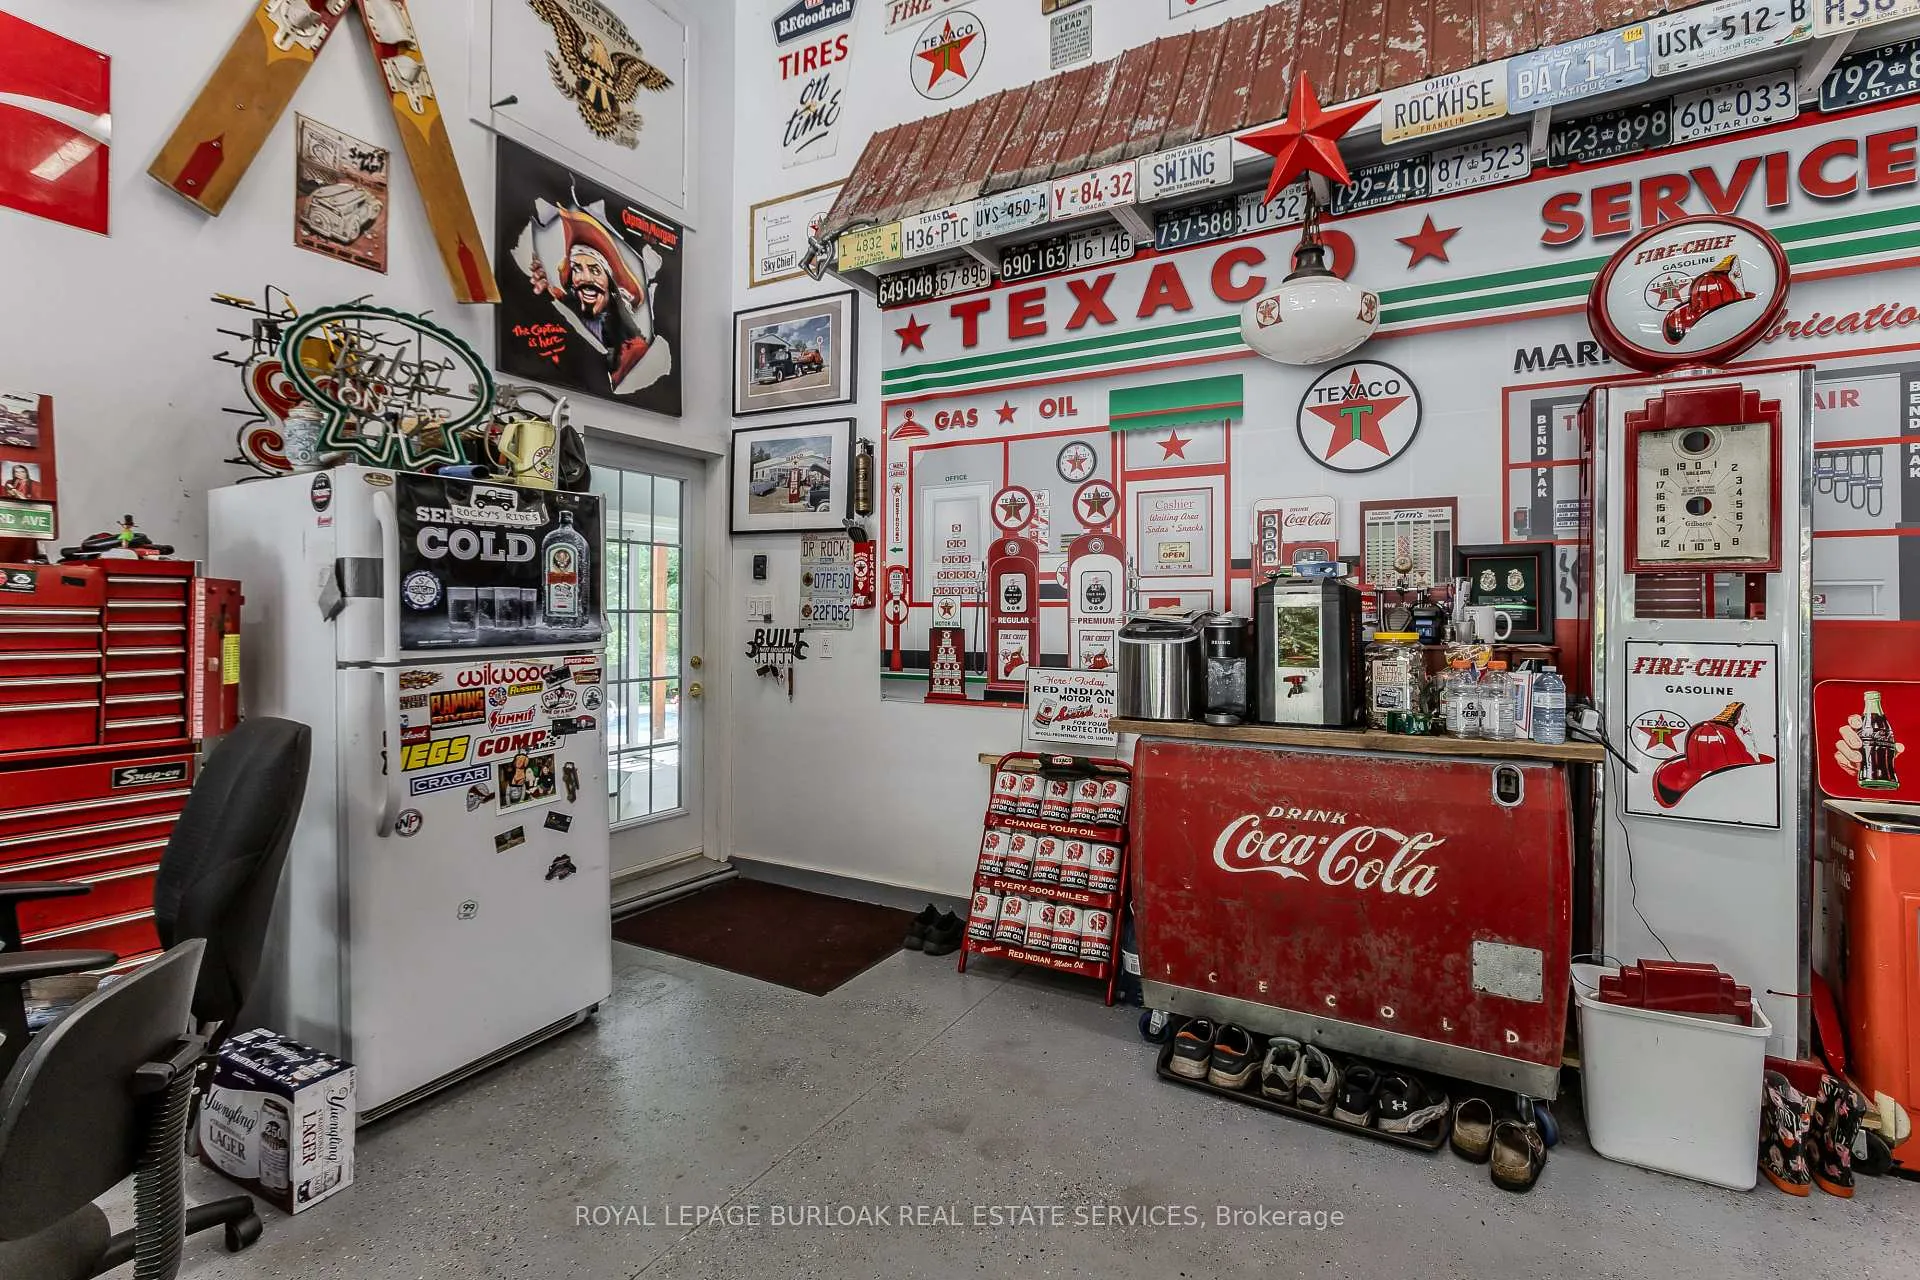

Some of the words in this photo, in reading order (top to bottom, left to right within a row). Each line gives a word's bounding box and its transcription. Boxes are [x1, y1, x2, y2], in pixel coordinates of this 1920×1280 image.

[1060, 19, 1082, 32] LEAD
[1657, 1, 1807, 57] USK-512-B
[921, 23, 975, 51] TEXACO
[778, 34, 848, 80] TIRES
[1518, 59, 1572, 99] BA7
[1584, 43, 1641, 82] 111
[1829, 61, 1885, 98] 792
[800, 72, 830, 105] on
[1424, 75, 1460, 92] OHIO
[1395, 79, 1494, 129] ROCKHSE
[1736, 82, 1792, 116] 033
[1420, 116, 1464, 133] FRANKLIN
[1551, 125, 1599, 158] N23
[1617, 110, 1667, 144] 898
[1692, 115, 1760, 137] ONTARIO
[1165, 146, 1203, 161] ONTARIO
[1481, 142, 1525, 173] 523
[1577, 142, 1639, 161] ONTARIO
[1153, 151, 1215, 187] SWING
[1360, 162, 1400, 176] ONTARIO
[1447, 172, 1500, 189] ONTARIO
[1540, 127, 1919, 245] SERVICE
[920, 214, 941, 225] TEXAS
[976, 193, 1047, 227] UVS-450-A
[622, 208, 649, 235] Captain
[649, 220, 679, 246] Morgan
[940, 218, 969, 243] PTC
[856, 237, 882, 252] 4832
[1634, 234, 1737, 266] FIRE-CHIEF
[763, 259, 776, 273] Sky
[777, 253, 794, 269] Chief
[1662, 255, 1716, 272] GASOLINE
[951, 230, 1356, 348] TEXACO
[513, 325, 530, 336] The
[531, 324, 567, 336] Captain
[539, 335, 564, 348] here
[1314, 379, 1402, 404] TEXACO
[934, 408, 979, 431] GAS
[1039, 395, 1078, 419] OIL
[1536, 414, 1547, 457] BEND
[1660, 468, 1669, 476] 18
[1677, 463, 1686, 471] 19
[1731, 463, 1738, 471] 2
[945, 474, 968, 482] OFFICE
[1537, 466, 1547, 498] PAK
[1656, 481, 1665, 489] 17
[1736, 488, 1742, 496] 4
[1155, 499, 1195, 510] Cashier
[1656, 504, 1665, 512] 15
[1736, 500, 1743, 508] 5
[23, 514, 48, 527] AVE
[456, 507, 500, 520] ROCKY'S
[506, 511, 538, 521] RIDES
[1149, 513, 1179, 522] Waiting
[1393, 510, 1423, 521] Tom's
[1736, 512, 1743, 520] 6
[1175, 523, 1204, 532] Snacks
[1736, 524, 1743, 532] 7
[416, 526, 536, 562] COLD
[803, 541, 814, 557] DR
[820, 540, 845, 557] ROCK
[1694, 543, 1704, 551] 10
[814, 572, 850, 589] 07PF30
[755, 628, 804, 647] BUILT
[1632, 656, 1768, 678] FIRE-CHIEF
[509, 682, 543, 694] RUSSELL
[1041, 676, 1072, 685] Here!
[1075, 677, 1108, 687] Today
[1665, 685, 1734, 696] GASOLINE
[1033, 686, 1059, 694] RED
[1064, 687, 1114, 697] INDIAN
[1060, 695, 1091, 703] MOTOR
[432, 690, 485, 713] FLAMING
[432, 711, 485, 723] RIVER
[1639, 717, 1686, 729] TEXACO
[478, 730, 547, 757] COMP
[120, 769, 181, 785] Snap-on
[416, 769, 486, 791] CRAGAR
[1267, 806, 1348, 825] DRINK
[1004, 818, 1047, 830] CHANGE
[1049, 824, 1078, 835] YOUR
[1080, 828, 1097, 837] OIL
[1212, 813, 1447, 898] Coca-Cola
[994, 880, 1027, 892] EVERY
[1029, 886, 1055, 896] 3000
[1057, 891, 1089, 902] MILES
[1008, 949, 1024, 959] RED
[1025, 951, 1051, 965] INDIAN
[1054, 959, 1073, 968] Motor
[1074, 961, 1084, 969] Oil
[203, 1088, 259, 1136] Yuengling
[326, 1086, 349, 1166] Yuengling
[209, 1125, 246, 1160] LAGER
[302, 1109, 318, 1167] LAGER
